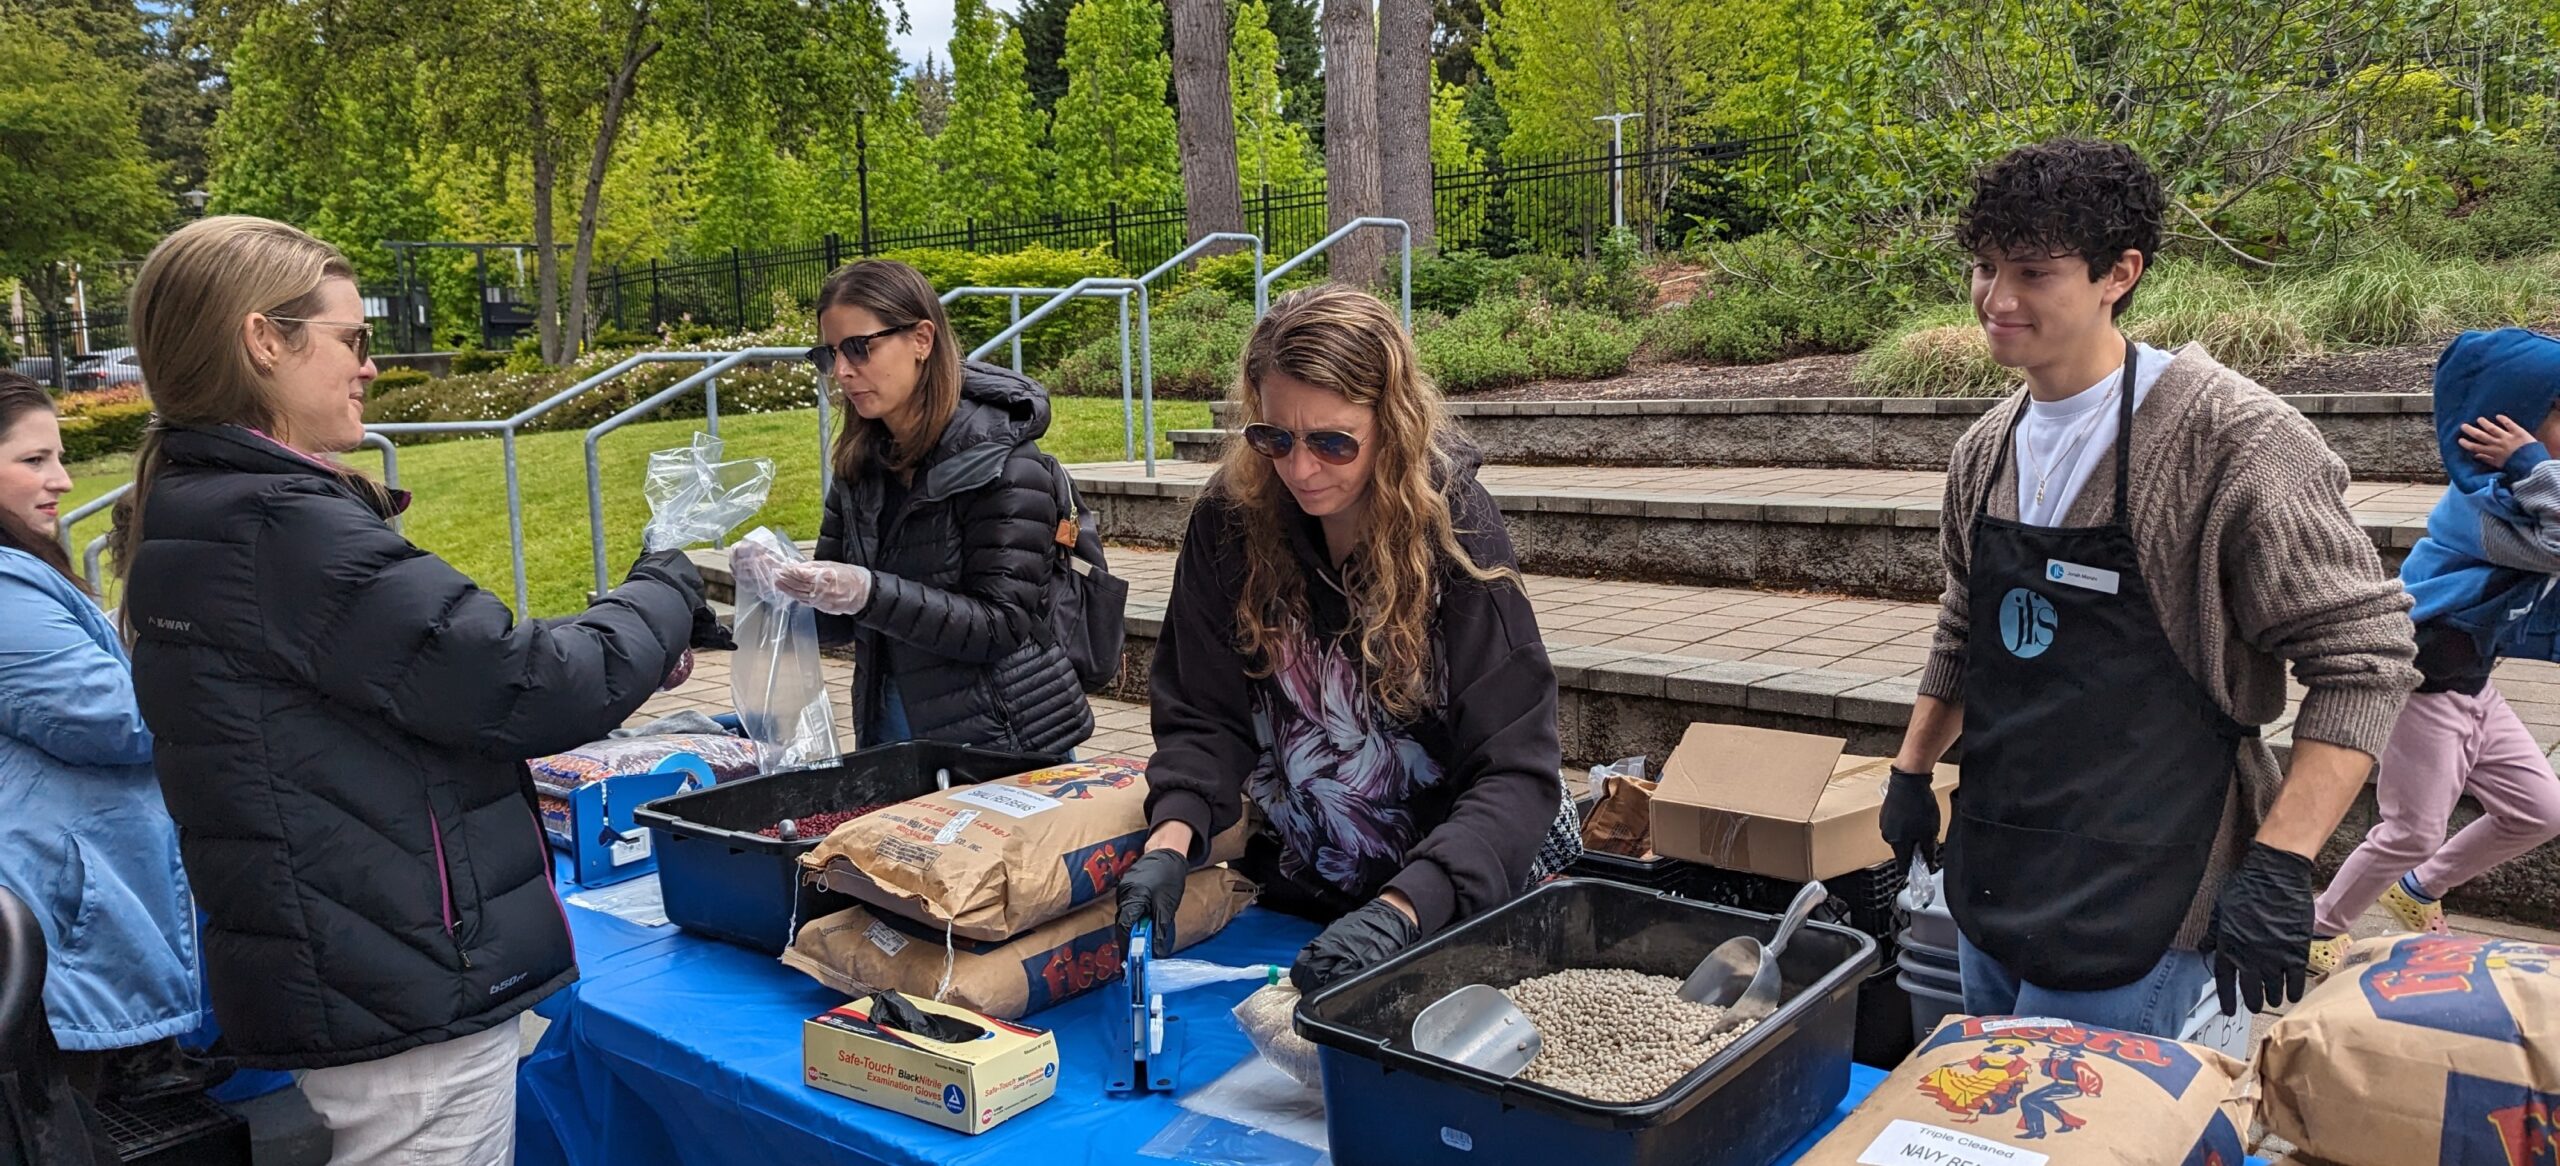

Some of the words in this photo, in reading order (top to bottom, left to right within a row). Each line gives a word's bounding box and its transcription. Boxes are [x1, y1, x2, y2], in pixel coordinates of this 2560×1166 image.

[1960, 1015, 2173, 1068] Festa
[838, 1049, 897, 1075] Safe-Touch
[897, 1069, 943, 1090] BlackNitrile
[866, 1071, 914, 1094] Examination
[914, 1085, 943, 1102] Gloves
[1899, 1143, 1950, 1163] NAVY
[1919, 1126, 1955, 1143] Triple
[1956, 1136, 2016, 1159] Cleaned
